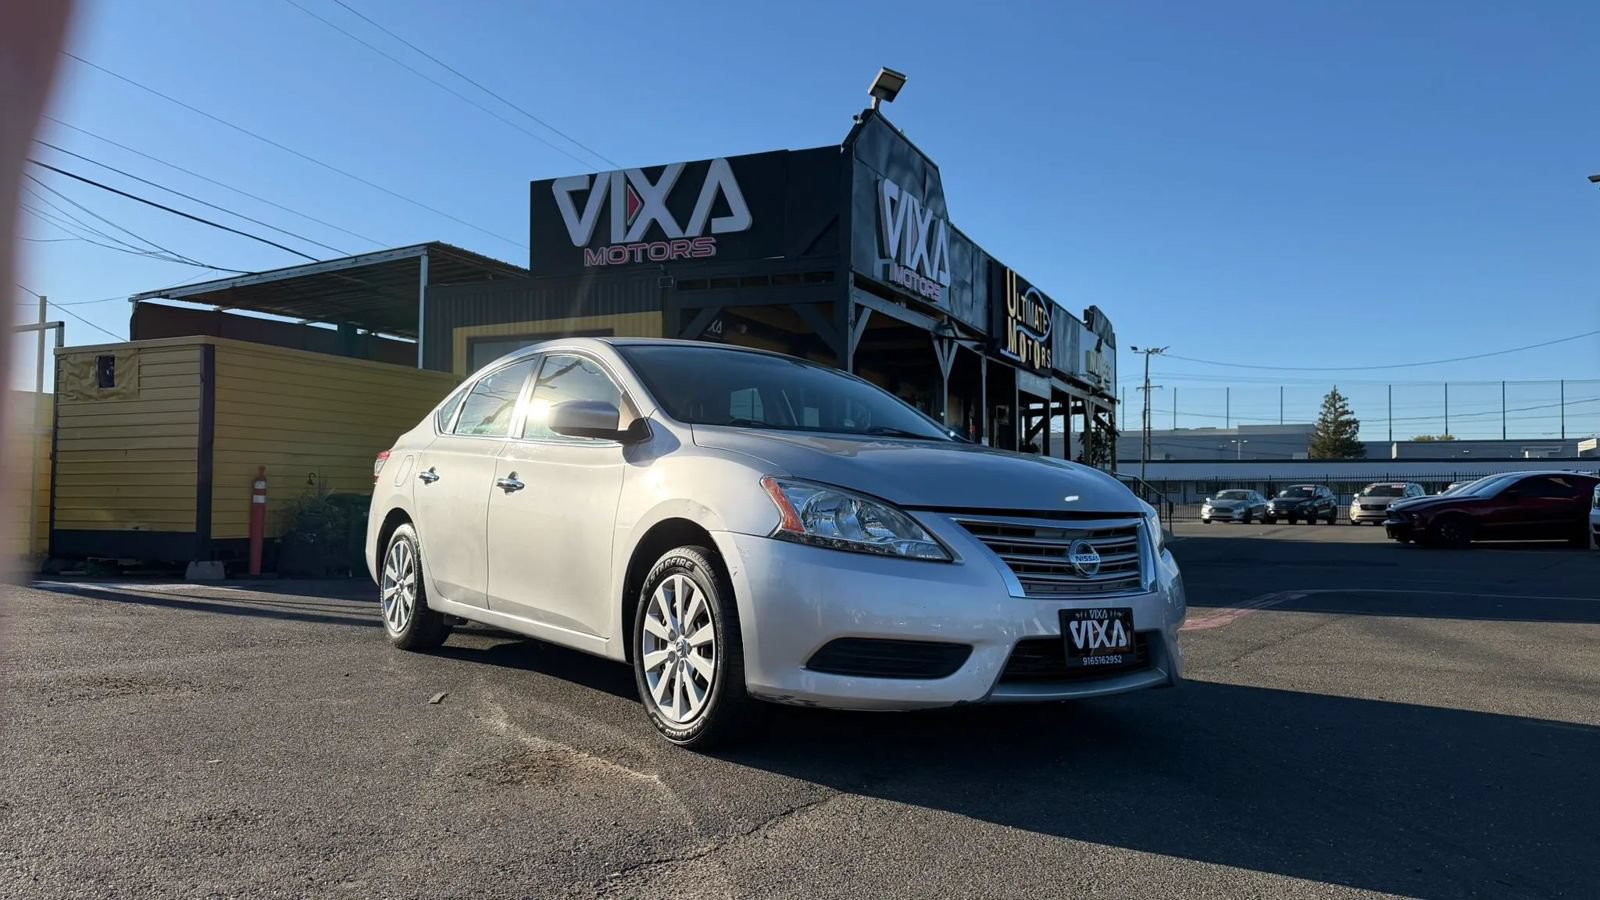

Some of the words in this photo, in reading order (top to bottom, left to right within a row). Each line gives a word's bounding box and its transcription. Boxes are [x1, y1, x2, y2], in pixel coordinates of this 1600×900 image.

[552, 157, 752, 247] VIXA
[881, 178, 951, 287] VIXA
[584, 237, 716, 266] MOTORS
[894, 265, 941, 301] MOTORS
[1006, 268, 1048, 334] ULTIMATE
[1008, 316, 1051, 370] MOTORS
[651, 557, 693, 583] STARFIRE
[1069, 619, 1127, 650] VIXA
[1082, 654, 1122, 666] 9165162952
